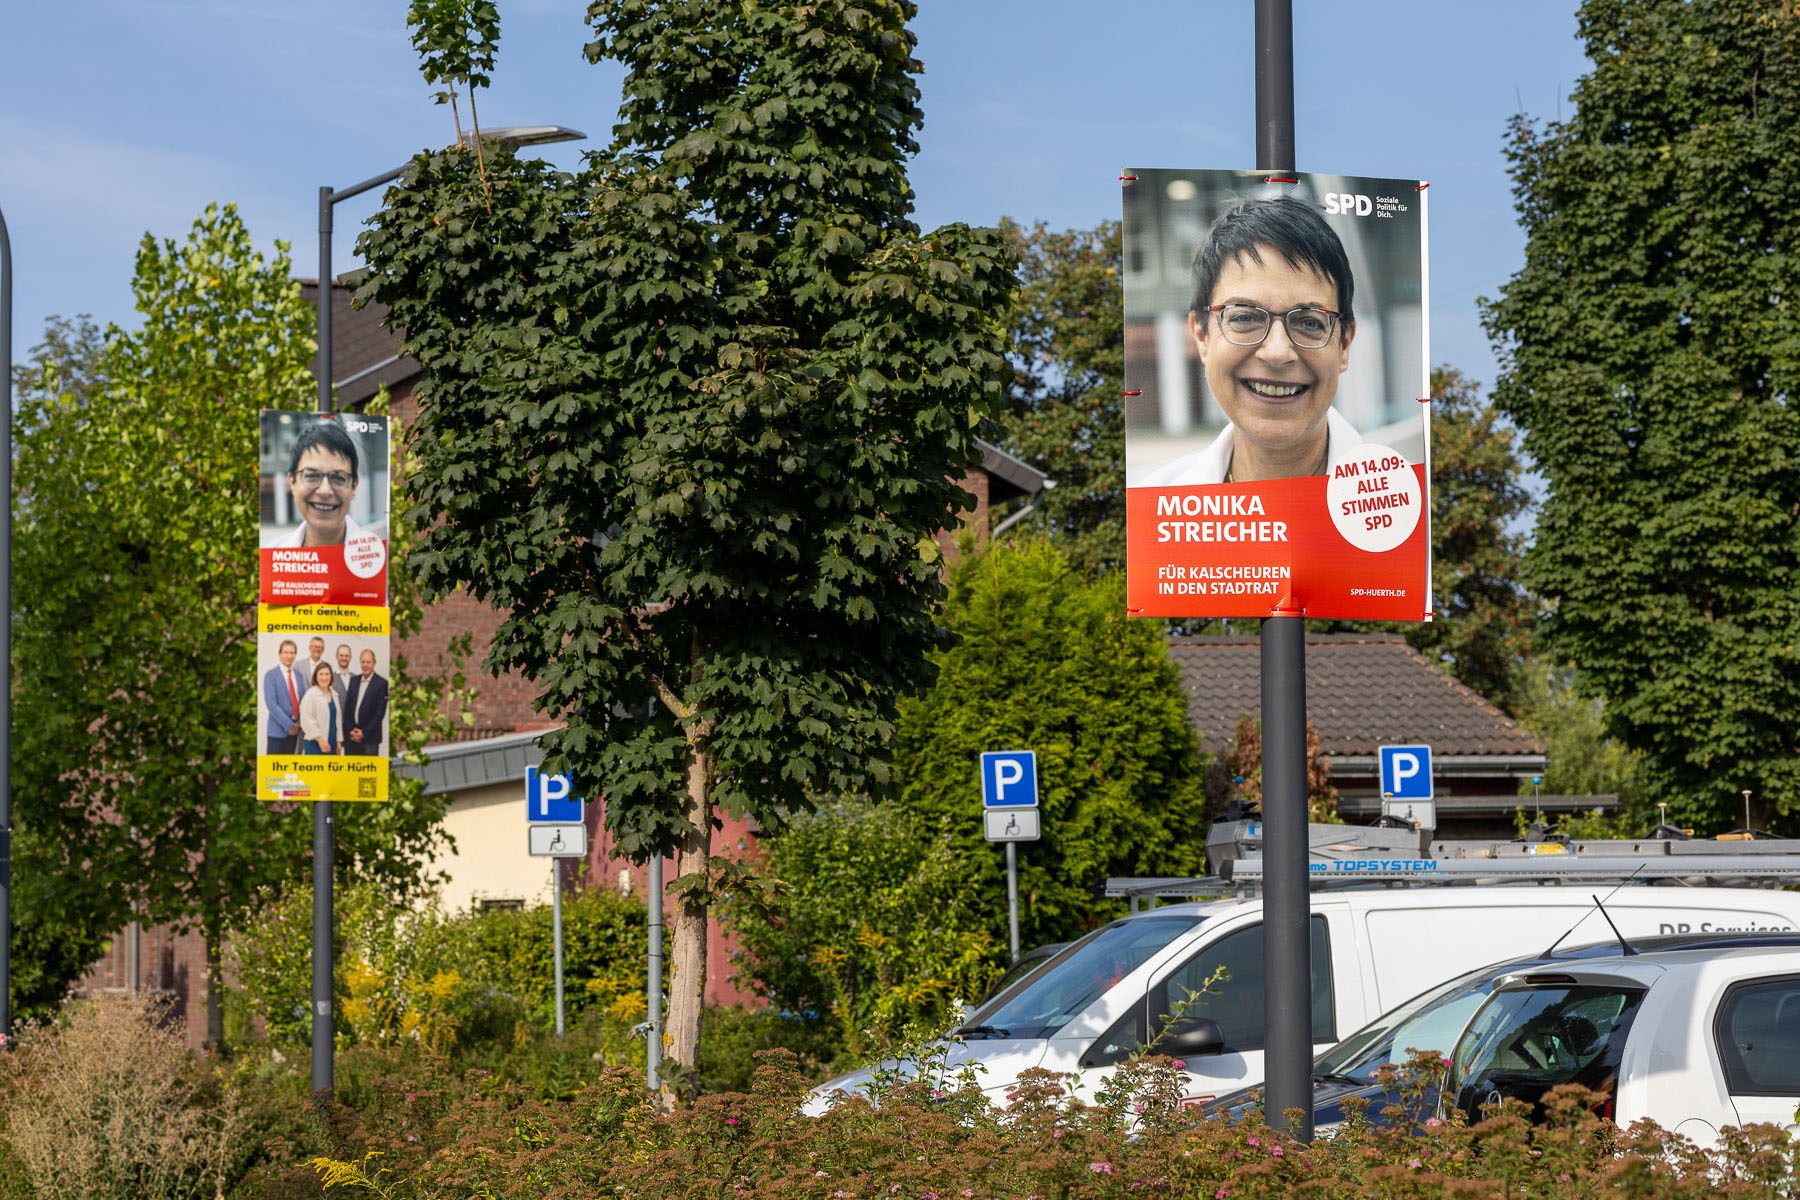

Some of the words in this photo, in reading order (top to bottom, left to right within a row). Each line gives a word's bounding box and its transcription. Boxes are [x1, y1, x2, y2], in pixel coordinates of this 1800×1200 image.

[1325, 192, 1373, 217] SPD
[1376, 196, 1399, 204] Soziale
[1397, 204, 1408, 212] für
[346, 421, 368, 433] SPD
[1334, 462, 1359, 480] AM
[1361, 456, 1405, 475] 14.09:
[1357, 477, 1389, 494] ALLE
[1157, 495, 1265, 516] MONIKA
[1341, 492, 1410, 515] STIMMEN
[1365, 514, 1393, 531] SPD
[1157, 521, 1288, 542] STREICHER
[272, 550, 319, 562] MONIKA
[272, 561, 328, 574] STREICHER
[1158, 564, 1186, 579] FÜR
[1189, 566, 1291, 579] KALSCHEUREN
[1158, 582, 1175, 594] IN
[1177, 582, 1208, 594] DEN
[1210, 582, 1280, 594] STADTRAT
[1350, 588, 1406, 597] SPD-HUERTH.DE
[292, 606, 312, 615] Frei
[317, 606, 360, 617] denken,
[267, 621, 332, 632] gemeinsam
[336, 621, 382, 633] handeln!
[272, 761, 288, 771] Ihr
[292, 762, 324, 772] Team
[328, 761, 344, 772] für
[347, 761, 377, 772] Hürth
[1392, 753, 1420, 793] P
[994, 759, 1023, 800] P
[540, 773, 570, 815] P
[1333, 860, 1437, 871] TOPSYSTEM
